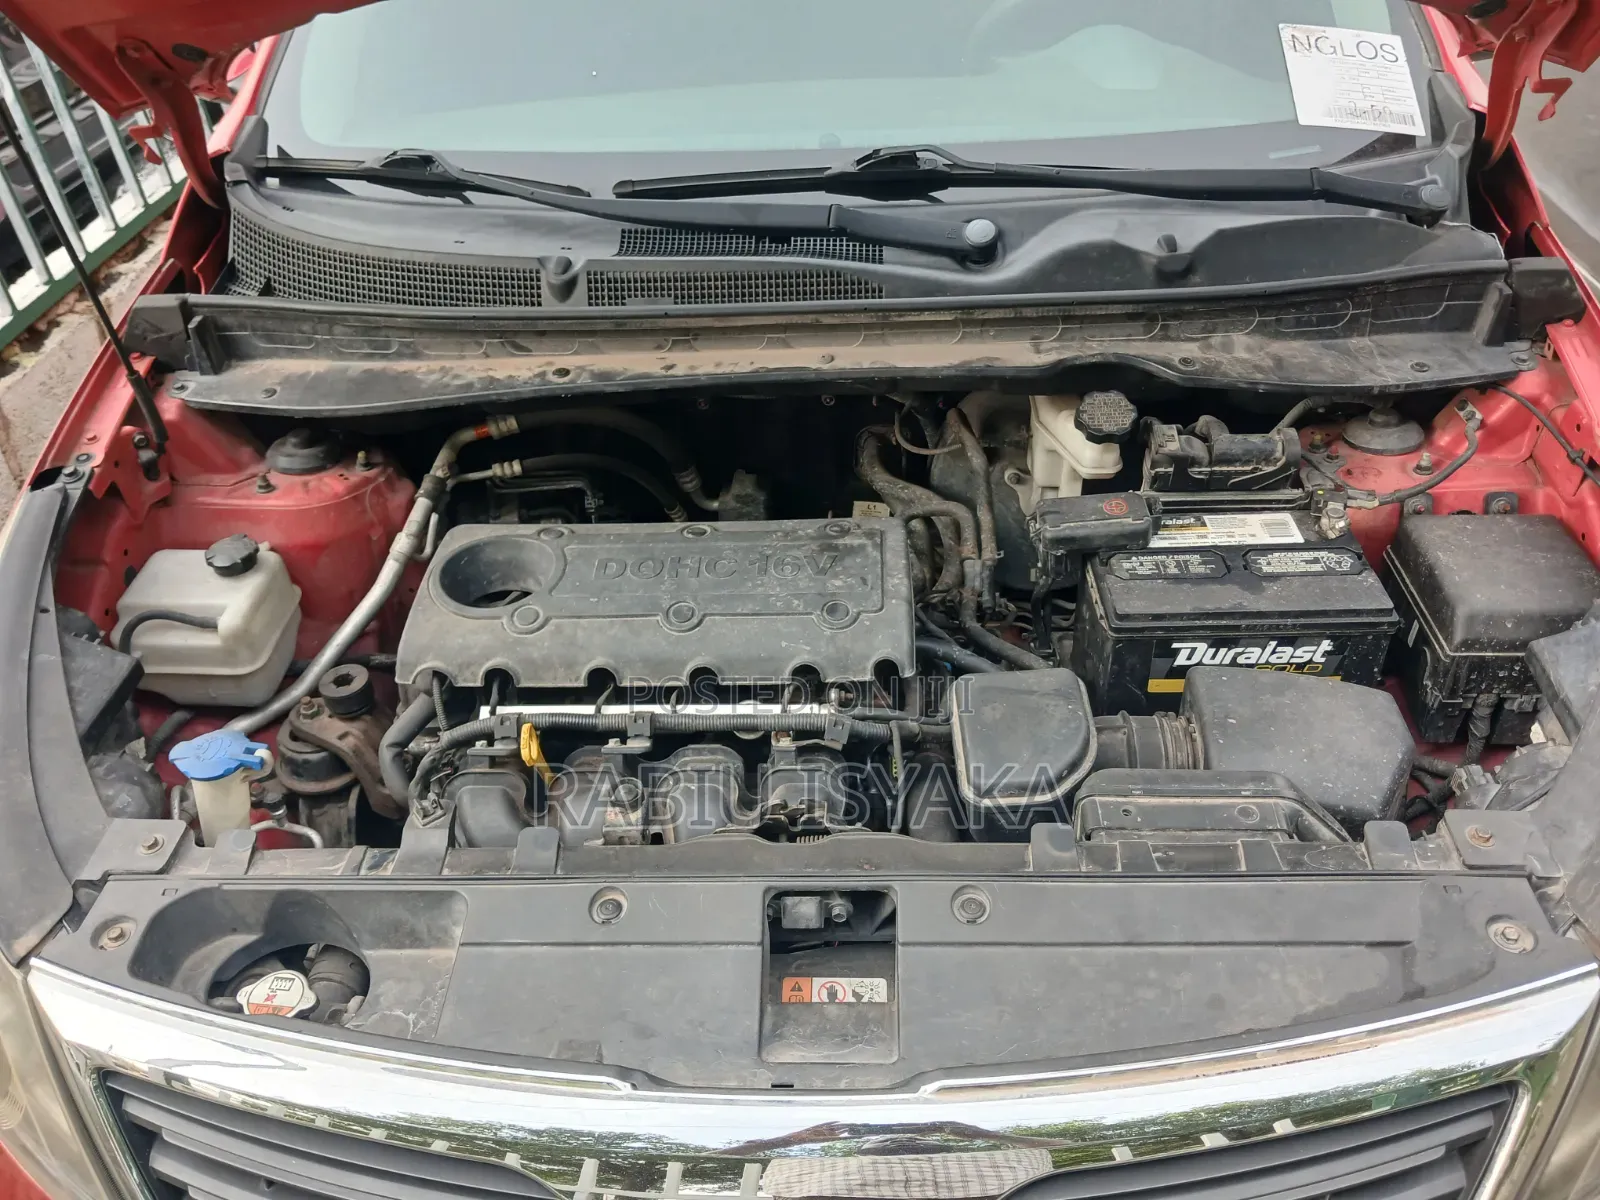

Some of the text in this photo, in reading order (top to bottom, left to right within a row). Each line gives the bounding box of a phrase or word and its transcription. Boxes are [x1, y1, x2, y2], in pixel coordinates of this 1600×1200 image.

[1291, 33, 1399, 63] NGLOS
[1161, 517, 1196, 525] ralast
[592, 553, 838, 580] DOHC 16V
[1170, 639, 1334, 667] Duralast
